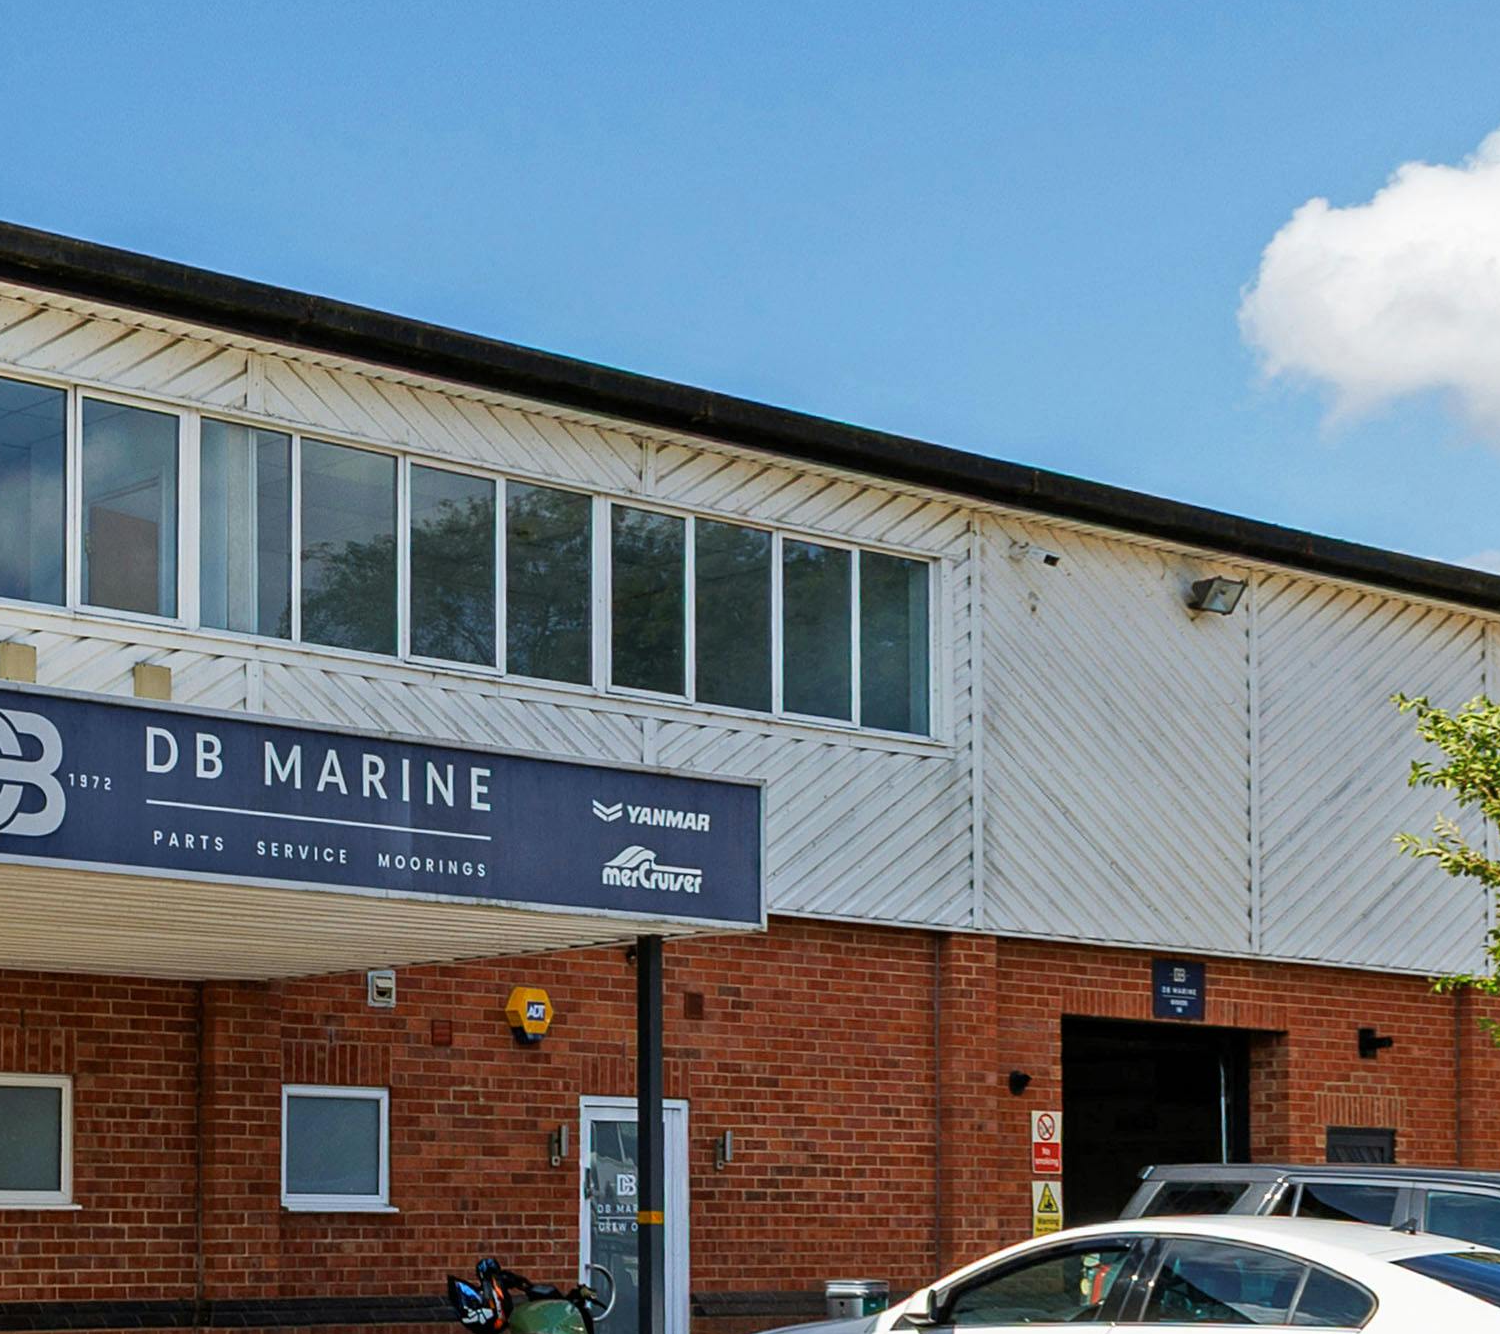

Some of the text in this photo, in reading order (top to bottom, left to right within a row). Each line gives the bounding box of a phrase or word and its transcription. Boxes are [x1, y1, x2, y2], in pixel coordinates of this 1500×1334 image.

[146, 726, 492, 812] DB MARINE
[68, 773, 112, 791] 1972
[627, 805, 711, 832] YANMAR
[153, 830, 487, 878] PARTS SERVICE MOORINGS
[527, 1004, 545, 1019] ADT
[616, 1174, 637, 1196] DB
[616, 1204, 638, 1214] MAR
